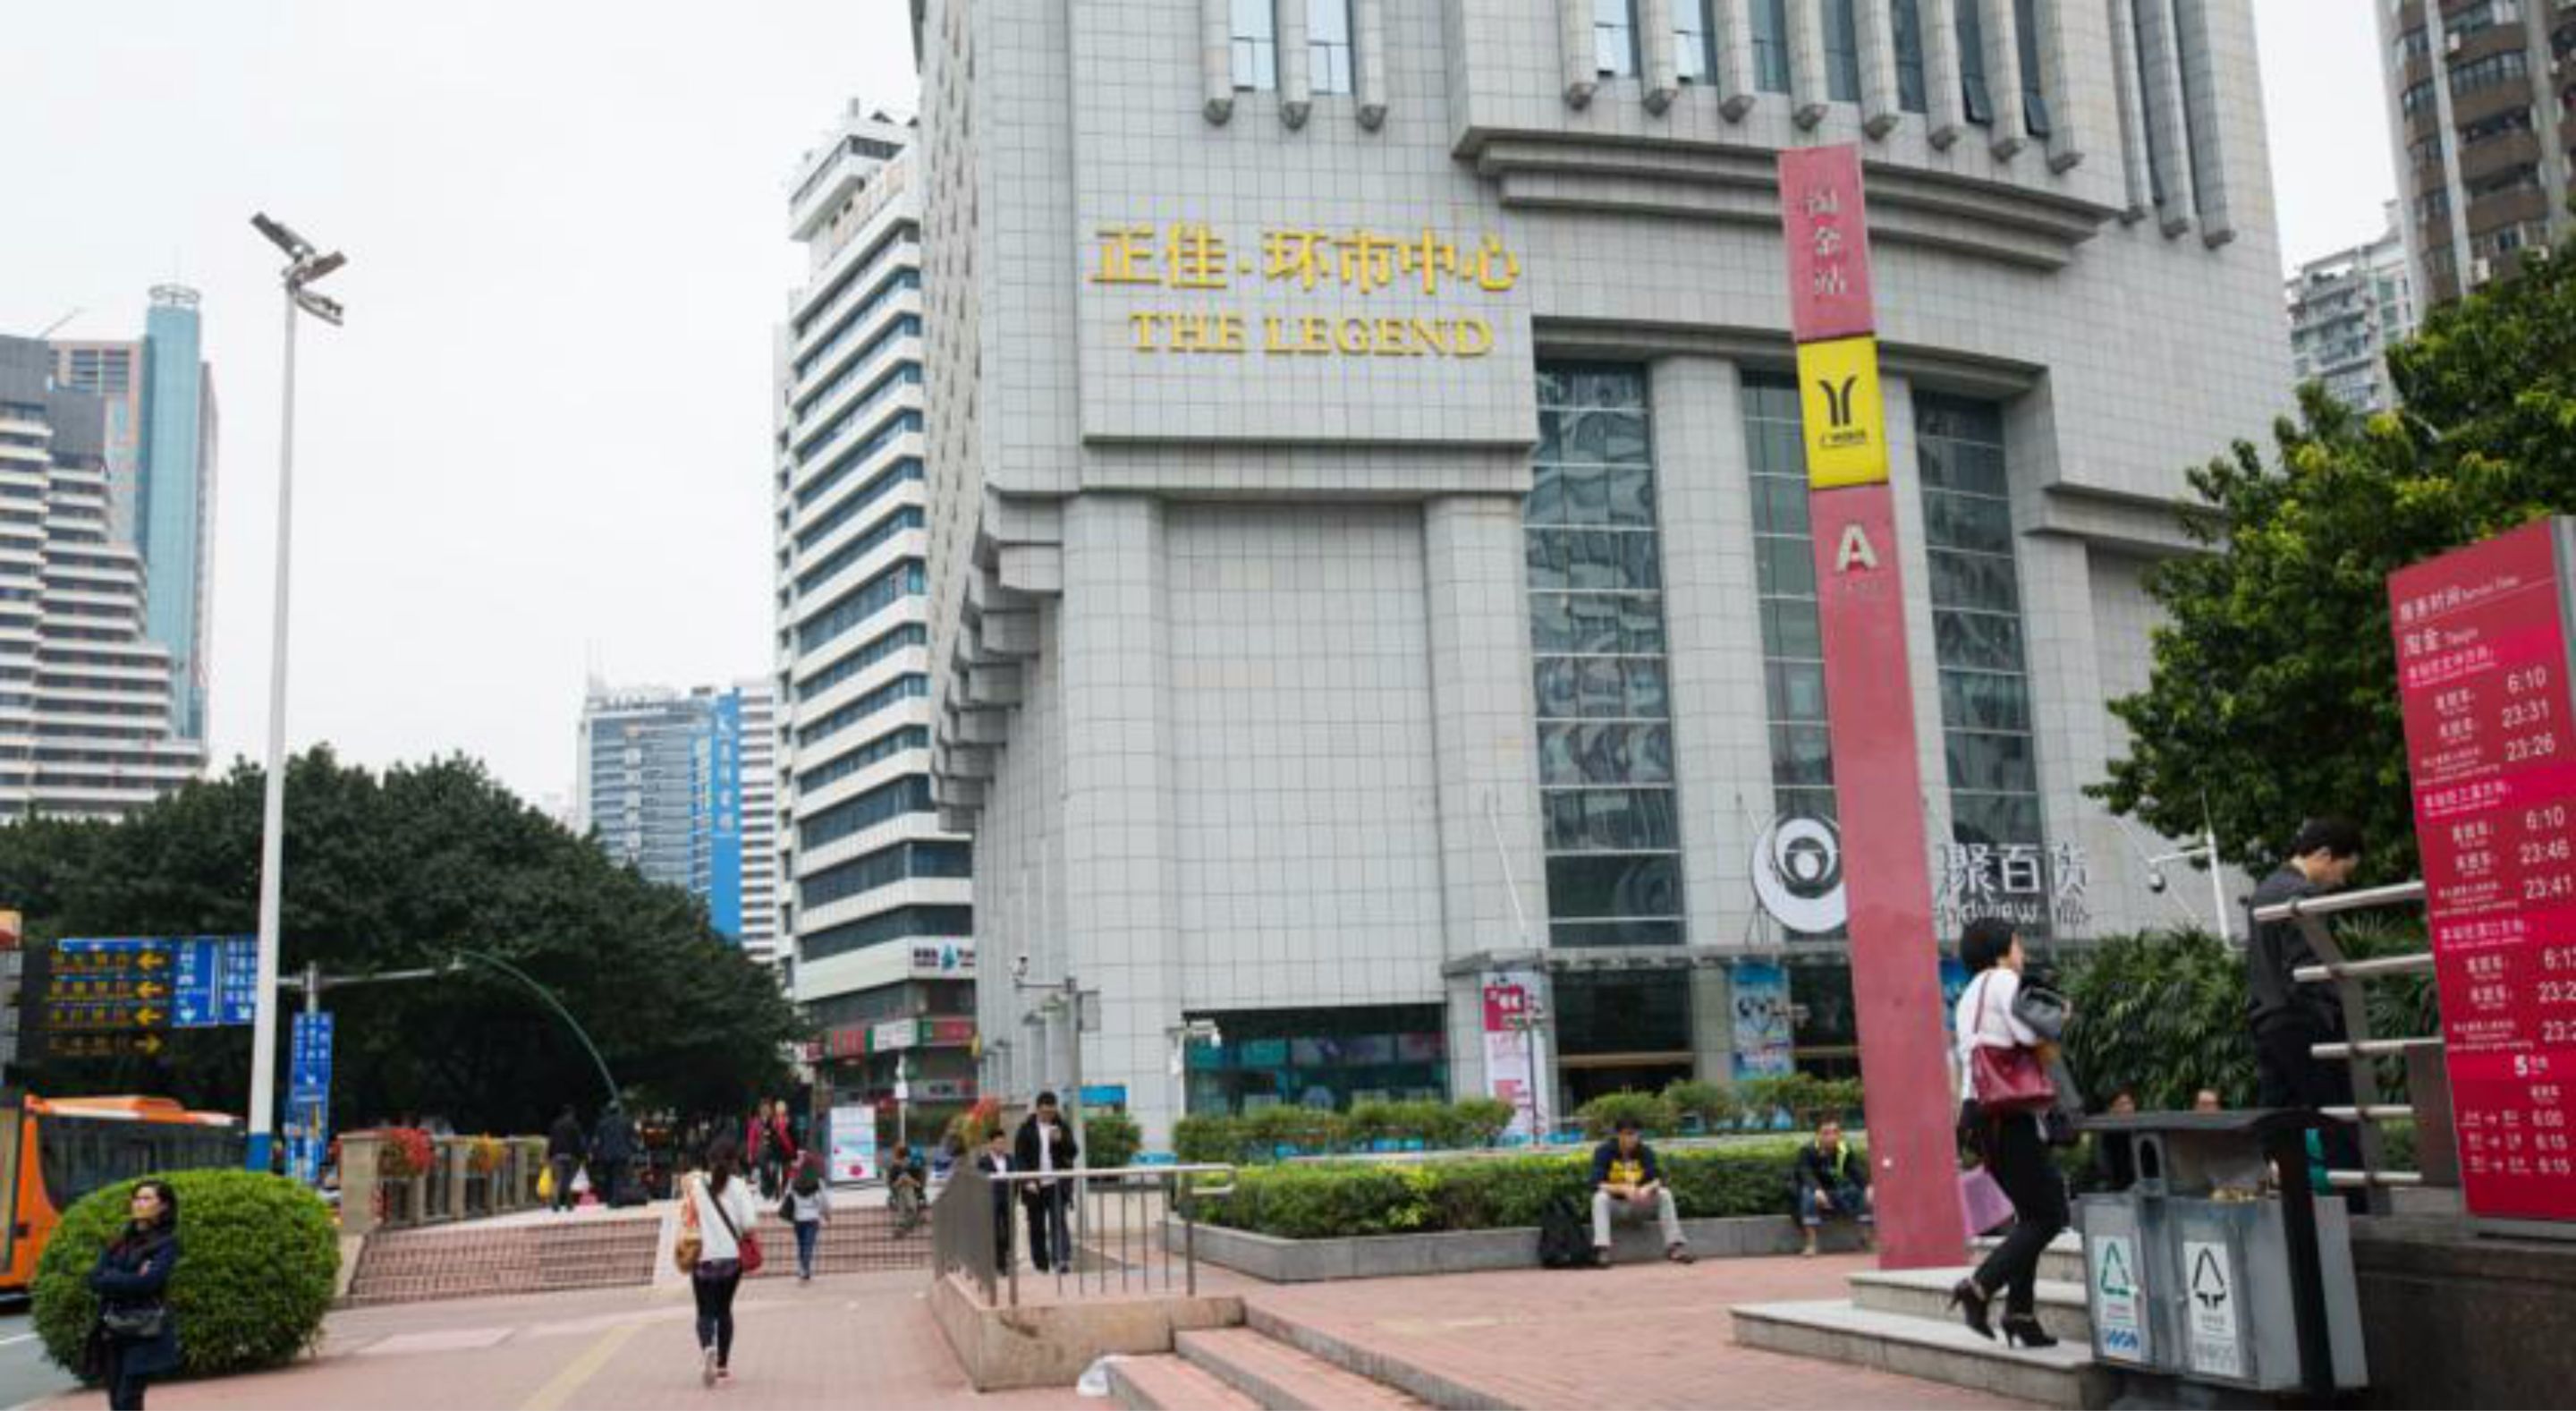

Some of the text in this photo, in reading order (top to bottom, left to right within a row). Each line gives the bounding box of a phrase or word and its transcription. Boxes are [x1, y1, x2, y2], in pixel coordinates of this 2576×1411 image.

[1804, 188, 1847, 294] 淘金站
[1130, 311, 1494, 357] THE LEGEND
[1834, 523, 1878, 573] A
[2404, 628, 2439, 657] 淘金
[2507, 666, 2546, 694] 6:10
[2502, 699, 2550, 728] 23:31
[2504, 733, 2555, 761] 23:26
[2526, 804, 2565, 830] 6:10
[2520, 838, 2570, 865] 23:46
[2523, 875, 2572, 900] 23:41
